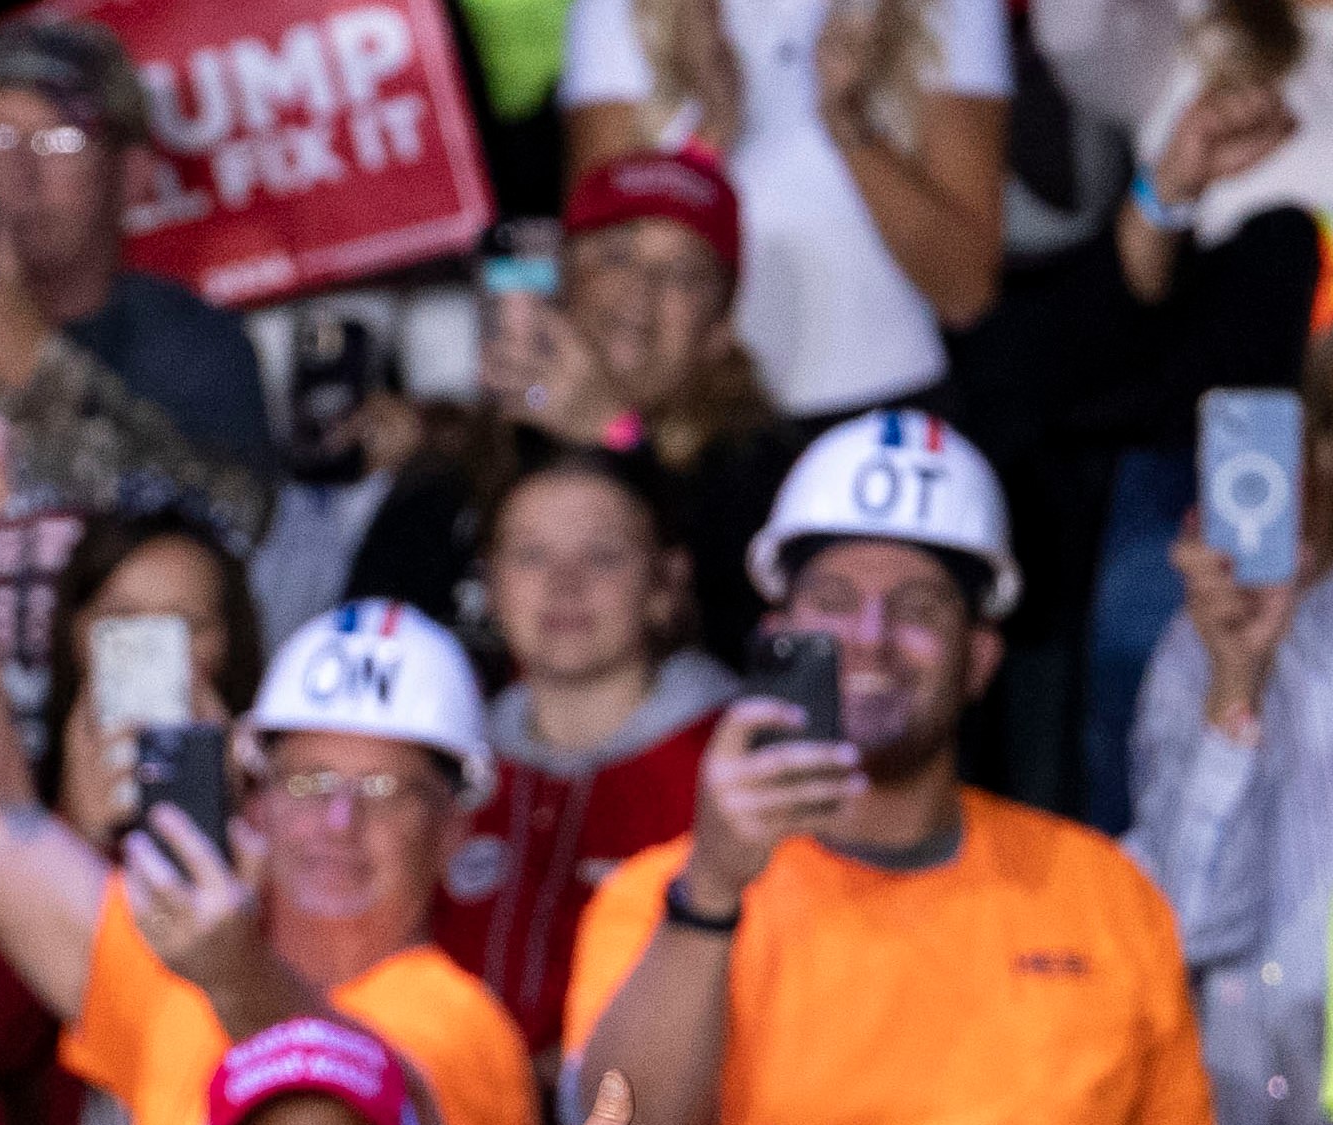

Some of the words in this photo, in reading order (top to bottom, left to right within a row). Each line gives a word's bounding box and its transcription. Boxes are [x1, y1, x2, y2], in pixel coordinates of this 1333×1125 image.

[351, 96, 423, 172] IT
[851, 458, 949, 524] OT
[303, 645, 403, 706] ON
